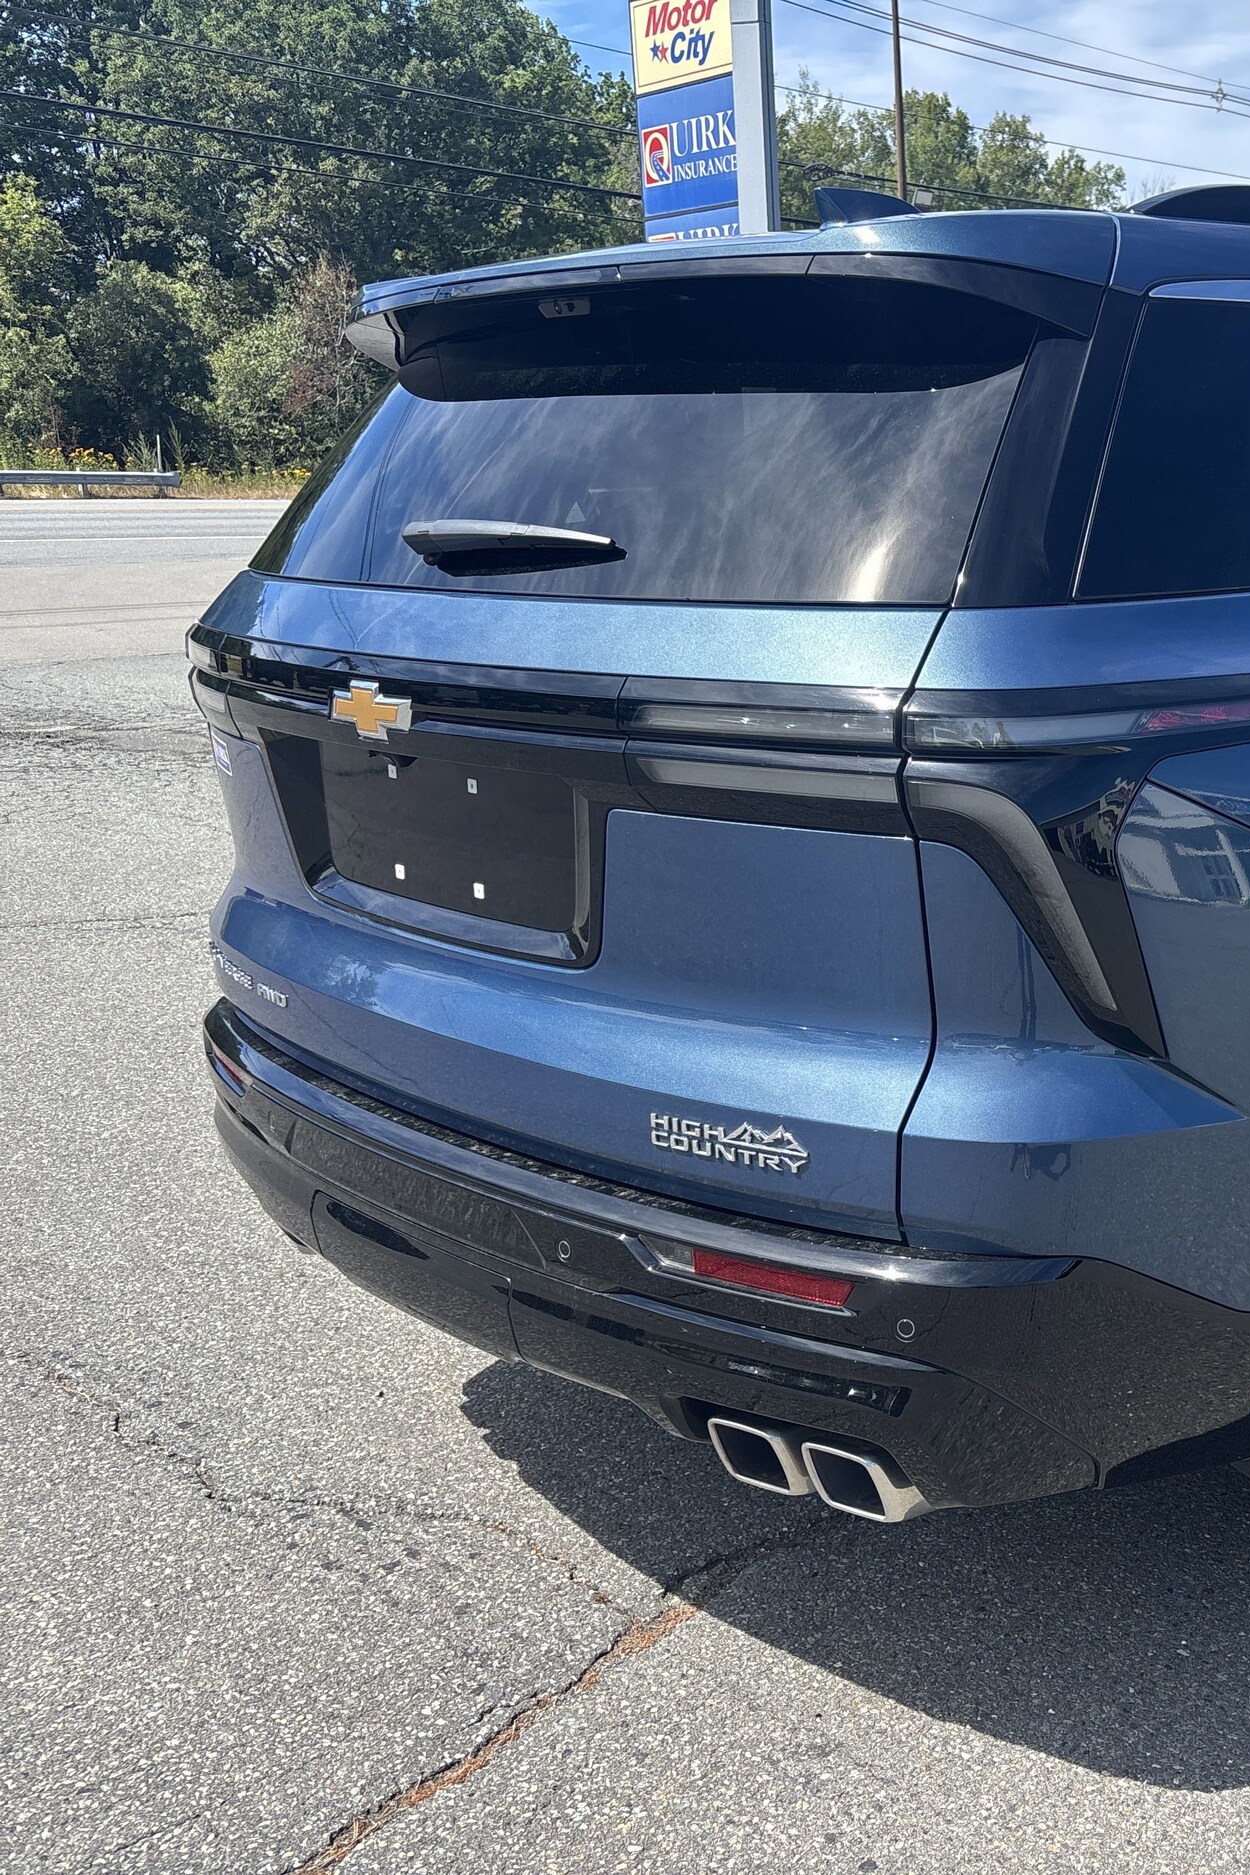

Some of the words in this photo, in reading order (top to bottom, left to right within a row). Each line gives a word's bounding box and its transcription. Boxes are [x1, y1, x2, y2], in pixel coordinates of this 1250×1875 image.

[645, 0, 718, 38] Motor
[670, 27, 715, 66] City
[673, 153, 738, 182] INSURANCE
[650, 1112, 725, 1142] HIGH
[651, 1129, 809, 1174] COUNTRY
